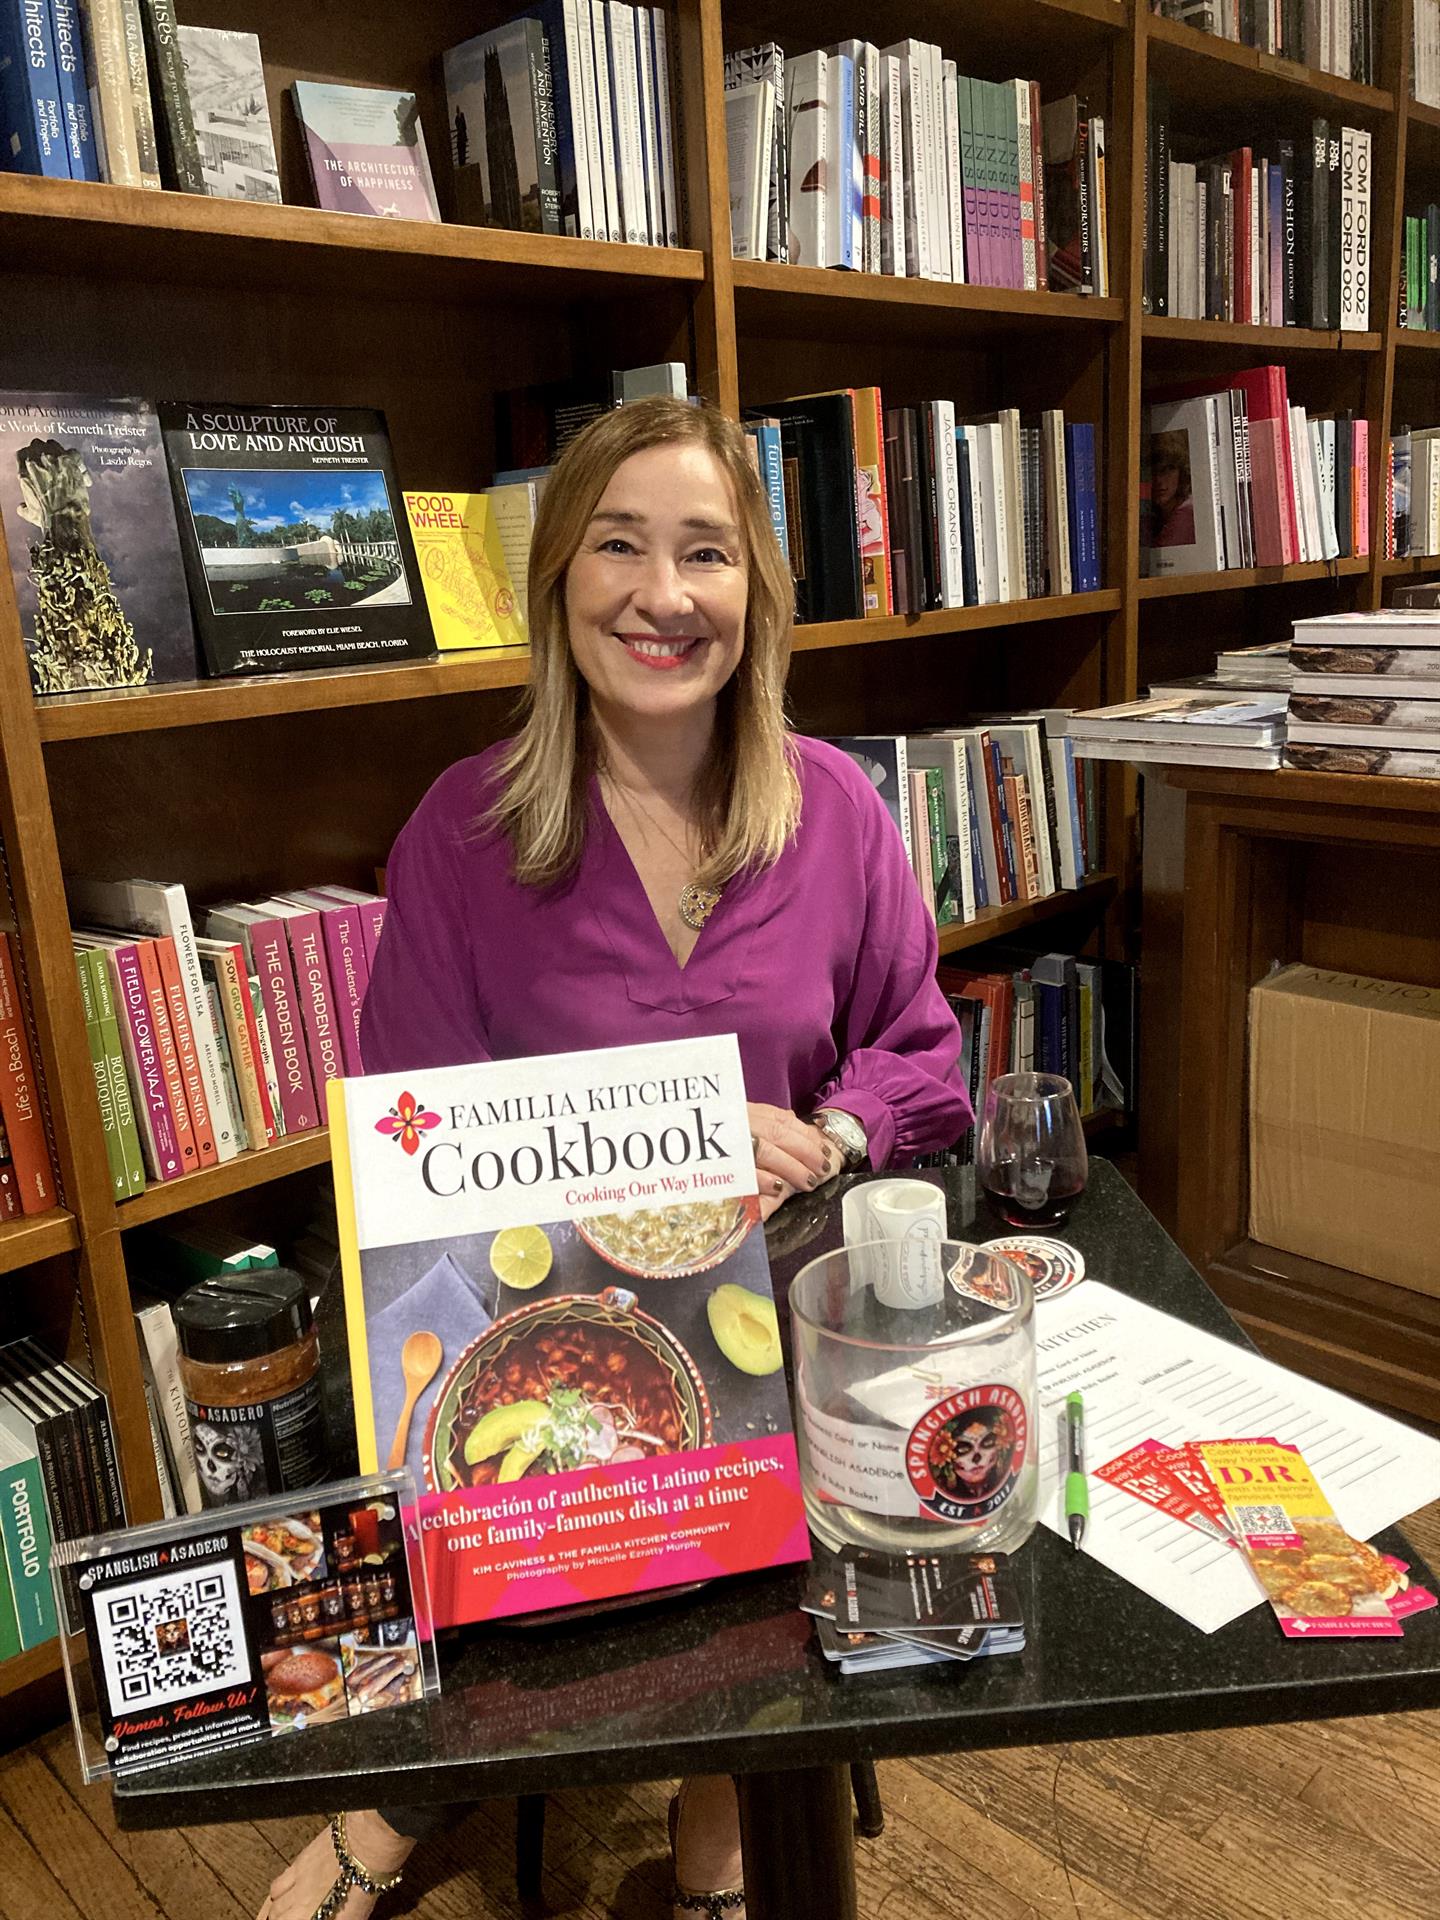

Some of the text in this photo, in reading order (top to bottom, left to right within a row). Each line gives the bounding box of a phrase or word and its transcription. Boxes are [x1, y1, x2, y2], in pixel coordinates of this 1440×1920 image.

[46, 100, 60, 138] Portfolio
[76, 104, 90, 141] Portfolio
[536, 70, 552, 165] AND INVENTION
[541, 37, 559, 155] BETWEEN MEMORY
[857, 66, 867, 136] DAVID GILL
[36, 98, 53, 156] and Projects
[66, 102, 82, 159] and Projects
[324, 160, 422, 176] THE ARCHITECTURE
[340, 176, 413, 191] OF HAPPINESS
[962, 129, 977, 235] INSIDE
[974, 133, 989, 236] INSIDE
[1079, 183, 1091, 252] DECORATORS
[1284, 179, 1295, 301] FASHION HISTORY
[1342, 136, 1354, 313] TOM FORD 002
[1356, 140, 1368, 314] TOM FORD 002
[8, 420, 146, 436] Work of Kenneth Treister
[187, 414, 337, 433] A SCULPTURE OF
[189, 433, 365, 452] LOVE AND ANGUISH
[100, 457, 152, 468] Laszlo Regos
[943, 413, 958, 554] JACQUES GRANGE
[406, 496, 453, 512] FOOD
[411, 513, 468, 528] WHEEL
[240, 639, 408, 658] THE HOLOCAUST MEMORIAL, MIAMI BEACH, FLORIDA
[900, 749, 908, 802] VICTORIA
[956, 747, 973, 859] MARKHAM ROBERTS
[1017, 798, 1034, 858] BOHEMIANS
[337, 920, 362, 1006] The Gardener's
[179, 924, 222, 1106] FLOWERS FOR LISA ABELARDO MORELL
[224, 959, 253, 1069] SOW GROW GATHER
[264, 940, 303, 1093] THE GARDEN BOOK
[301, 933, 339, 1083] THE GARDEN BOOK
[95, 961, 133, 1126] LAURA DOWLING BOUQUETS
[150, 988, 190, 1132] FLOWERS BY DESIGN
[169, 984, 208, 1127] FLOWERS BY DESIGN
[255, 1014, 272, 1065] Floriography
[3, 1027, 33, 1121] Life's a Beach
[92, 1060, 116, 1132] BOUQUETS
[448, 1072, 722, 1132] FAMILIA KITCHEN
[421, 1107, 731, 1197] Cookbook
[565, 1171, 735, 1206] Cooking Our Way Home
[1036, 1313, 1118, 1352] KITCHEN
[208, 1405, 264, 1422] ASADERO
[910, 1391, 981, 1480] SPANGLISH
[988, 1389, 1024, 1452] ASADERO
[97, 1419, 124, 1517] JEAN PROUVÉ ARCHITECTURE
[1207, 1448, 1276, 1458] Cook your
[1217, 1465, 1310, 1484] D.R.
[10, 1478, 40, 1577] PORTFOLIO
[404, 1456, 784, 1543] A celebración of authentic Latino recipes,
[447, 1483, 749, 1553] one family-famous dish at a time
[938, 1485, 1011, 1517] EST 2017
[88, 1536, 229, 1582] SPANGLISH ASADERO
[473, 1522, 731, 1576] KIM CAVINESS & THE FAMILIA KITCHEN COMMUNITY
[507, 1539, 702, 1581] Photography by Michelle Ezratty Murphy
[113, 1688, 257, 1739] Vamos, Follow Us!
[114, 1745, 167, 1766] collaboration
[168, 1734, 221, 1752] opportunities
[222, 1729, 237, 1737] and
[238, 1721, 261, 1732] more!
[122, 1715, 253, 1753] Find recipes, product information,
